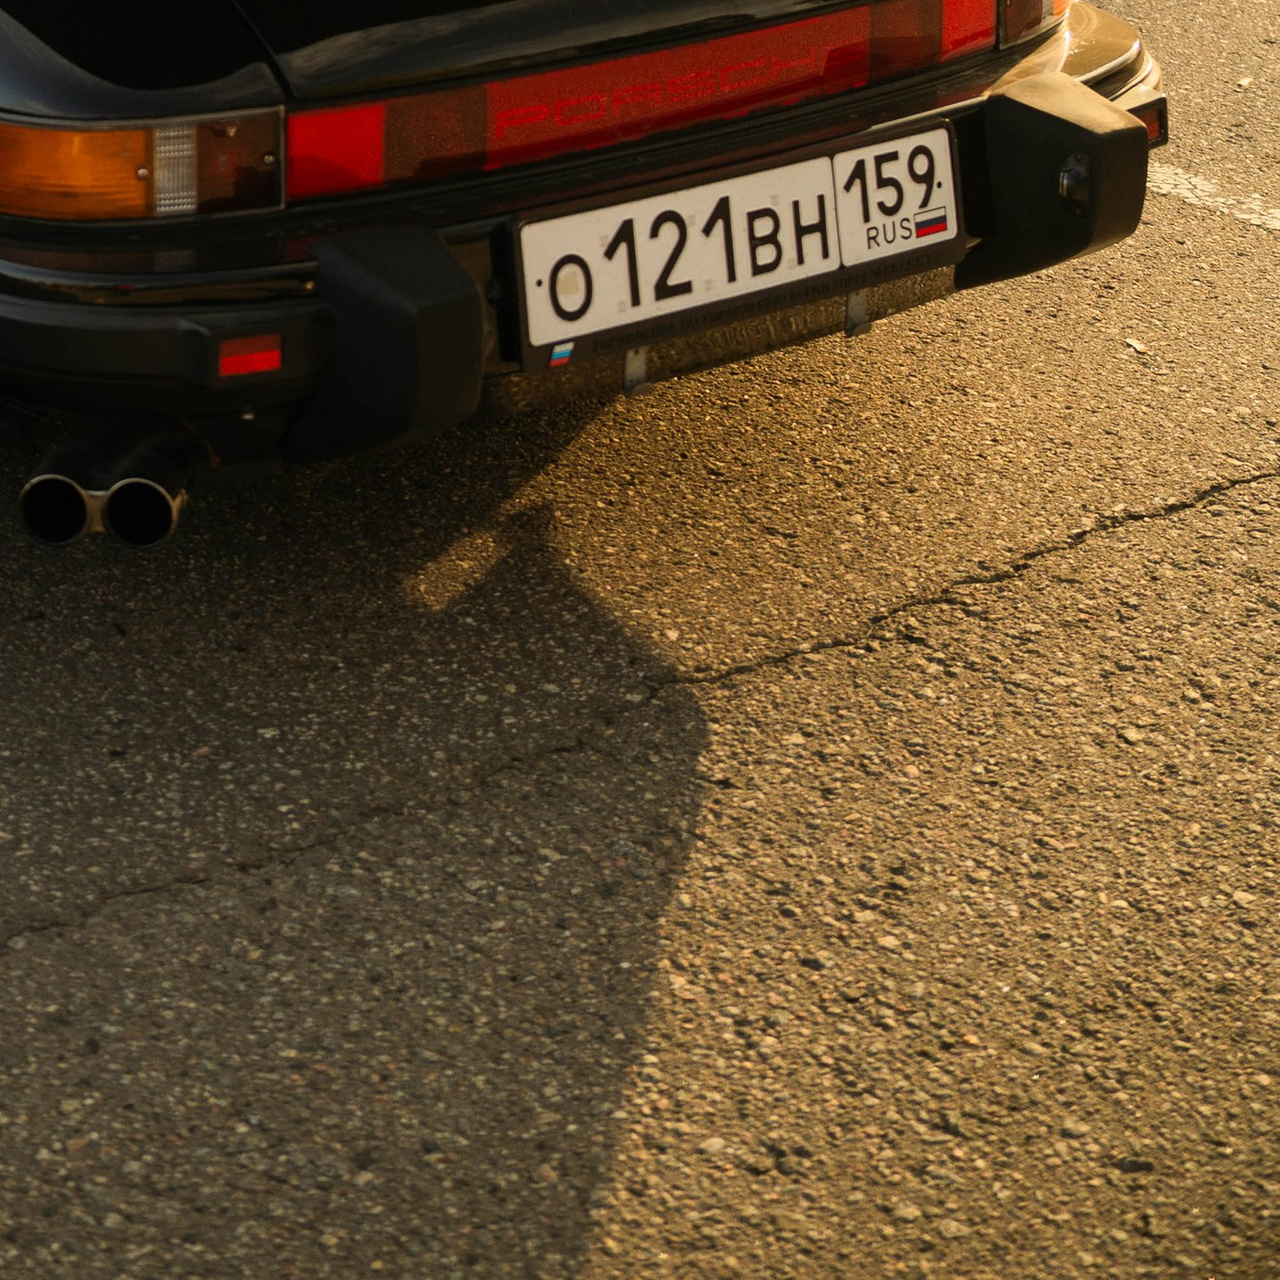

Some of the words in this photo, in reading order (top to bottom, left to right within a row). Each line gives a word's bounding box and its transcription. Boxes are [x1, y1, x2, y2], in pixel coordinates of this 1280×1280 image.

[495, 45, 862, 136] PORSCHE
[842, 144, 936, 223] 159
[866, 217, 913, 250] RUS
